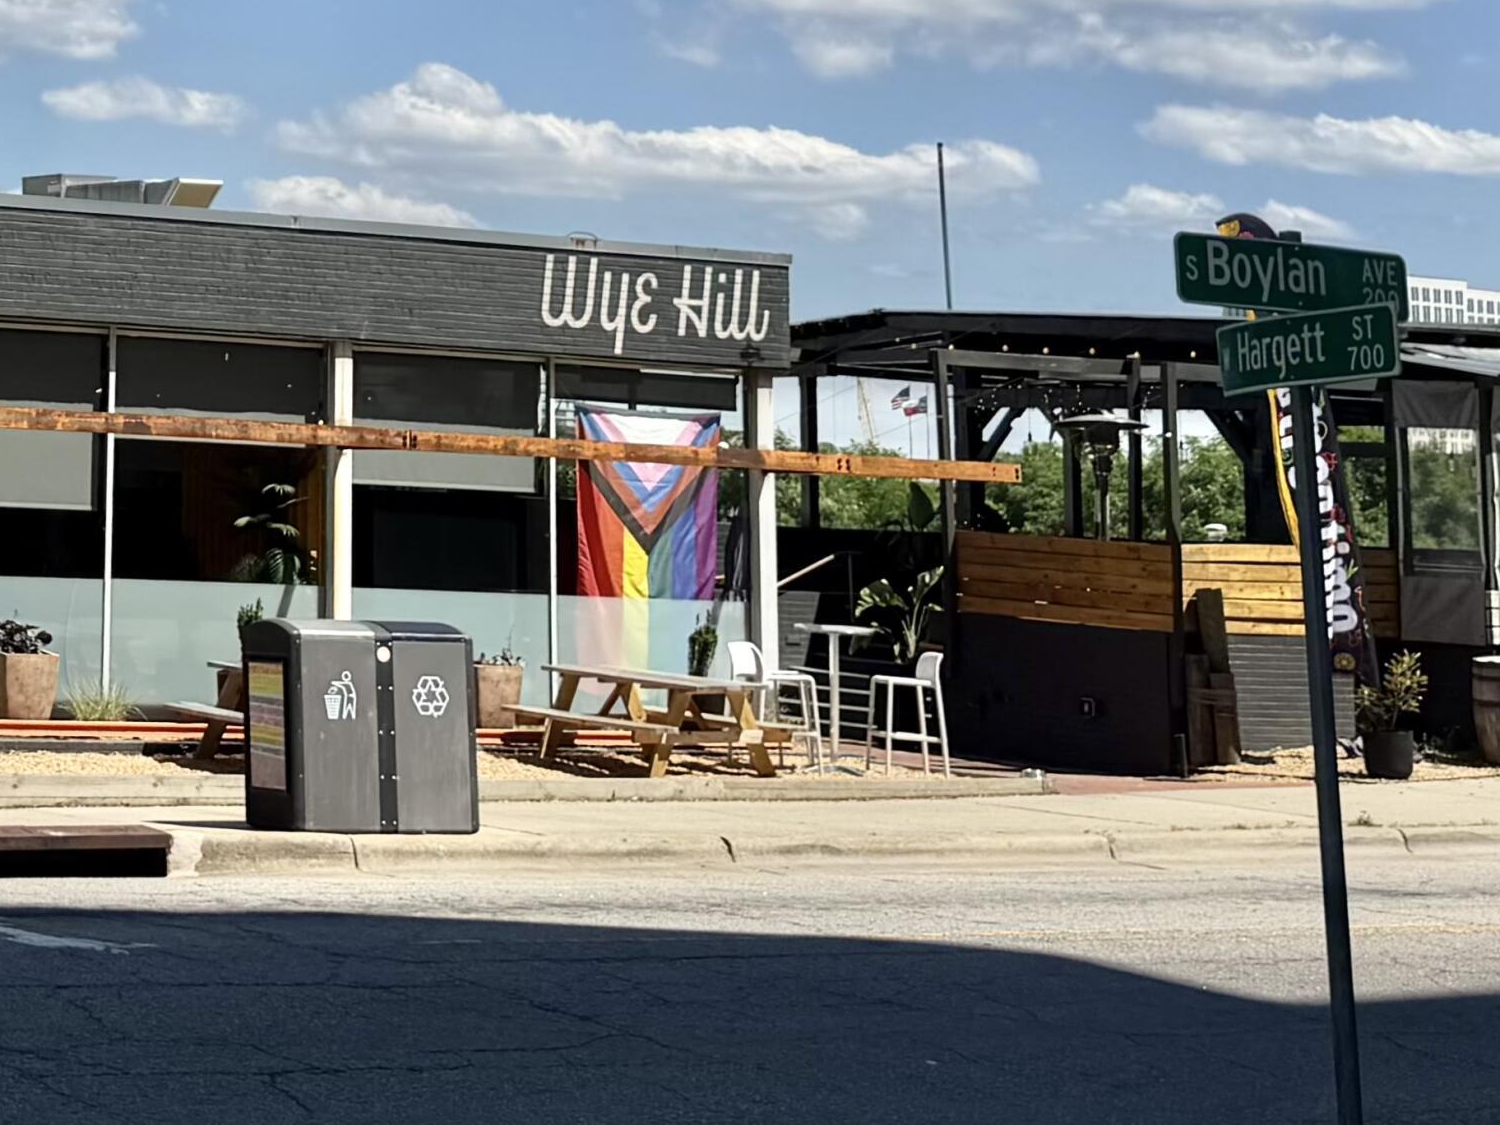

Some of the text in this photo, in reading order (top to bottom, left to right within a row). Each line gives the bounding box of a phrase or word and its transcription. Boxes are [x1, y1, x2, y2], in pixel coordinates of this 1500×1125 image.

[672, 264, 771, 342] Hill
[1185, 239, 1399, 303] S Boylan AVE
[1236, 321, 1326, 380] Hargett
[1352, 314, 1373, 341] ST
[1346, 344, 1385, 371] 700
